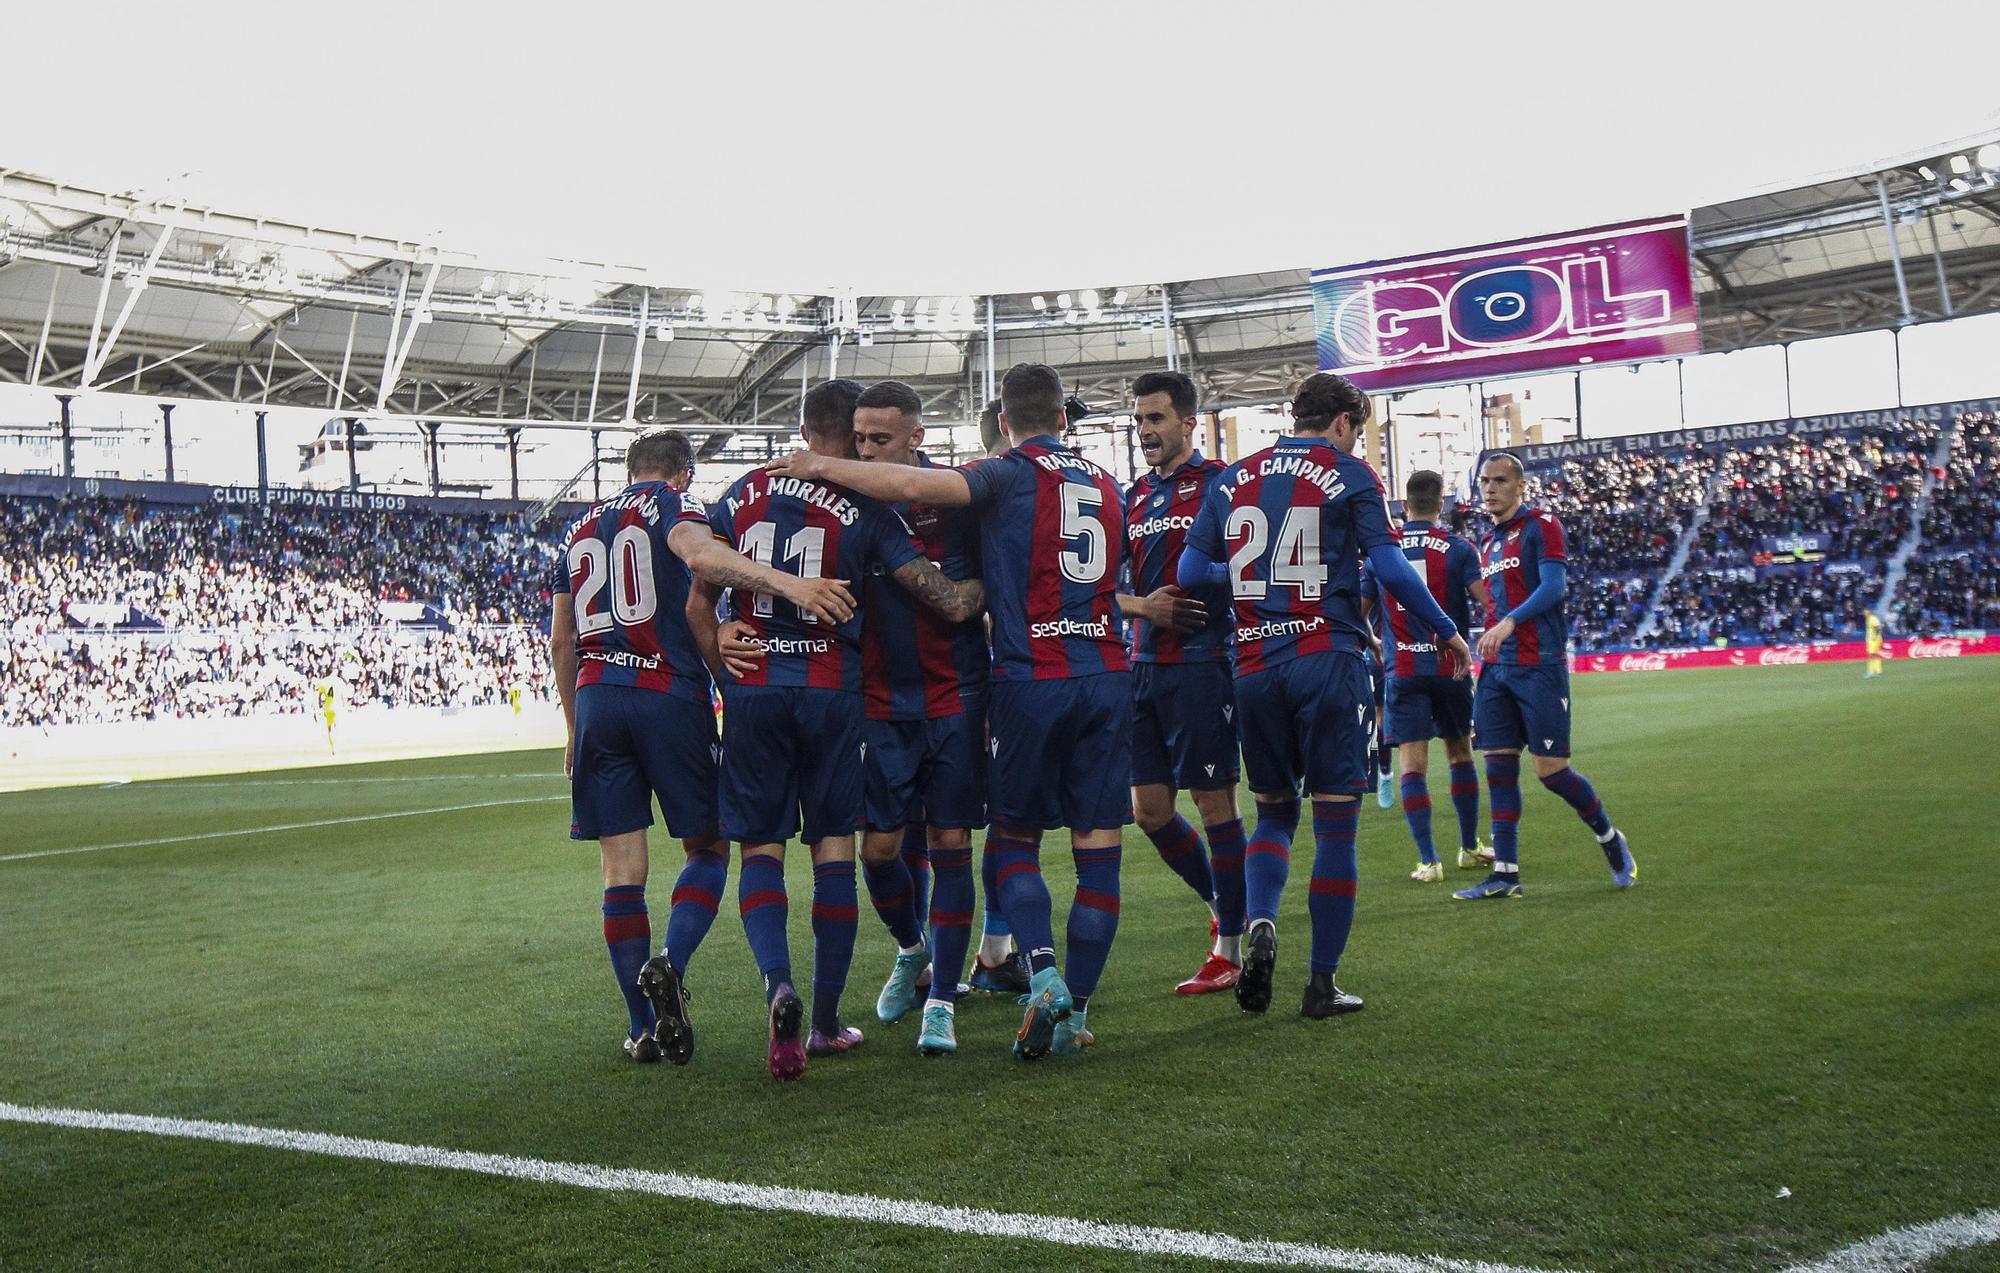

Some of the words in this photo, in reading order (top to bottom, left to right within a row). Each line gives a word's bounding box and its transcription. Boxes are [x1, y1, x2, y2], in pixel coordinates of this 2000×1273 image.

[1335, 256, 1671, 362] GOL
[1625, 436, 1651, 451] EN
[1660, 431, 1697, 448] LAS
[1703, 421, 1787, 443] BARRAS
[1794, 406, 1943, 433] AZULGRANAS
[213, 488, 259, 503] CLUB
[266, 489, 335, 507] FUNDAT
[341, 493, 363, 508] EN
[368, 495, 406, 510] 1909
[726, 496, 744, 517] A.
[746, 482, 761, 505] J.
[766, 477, 860, 526] MORALES
[1219, 484, 1236, 503] J.
[1236, 468, 1255, 486] G.
[1260, 457, 1346, 500] CAMPAÑA
[1059, 481, 1107, 583] 5
[1128, 516, 1194, 541] Gedesco
[1421, 535, 1451, 554] PIER
[738, 521, 826, 624] 11
[1224, 505, 1328, 601] 24
[567, 524, 657, 640] 20
[1031, 617, 1107, 638] sesderma
[1237, 619, 1319, 642] sesderma
